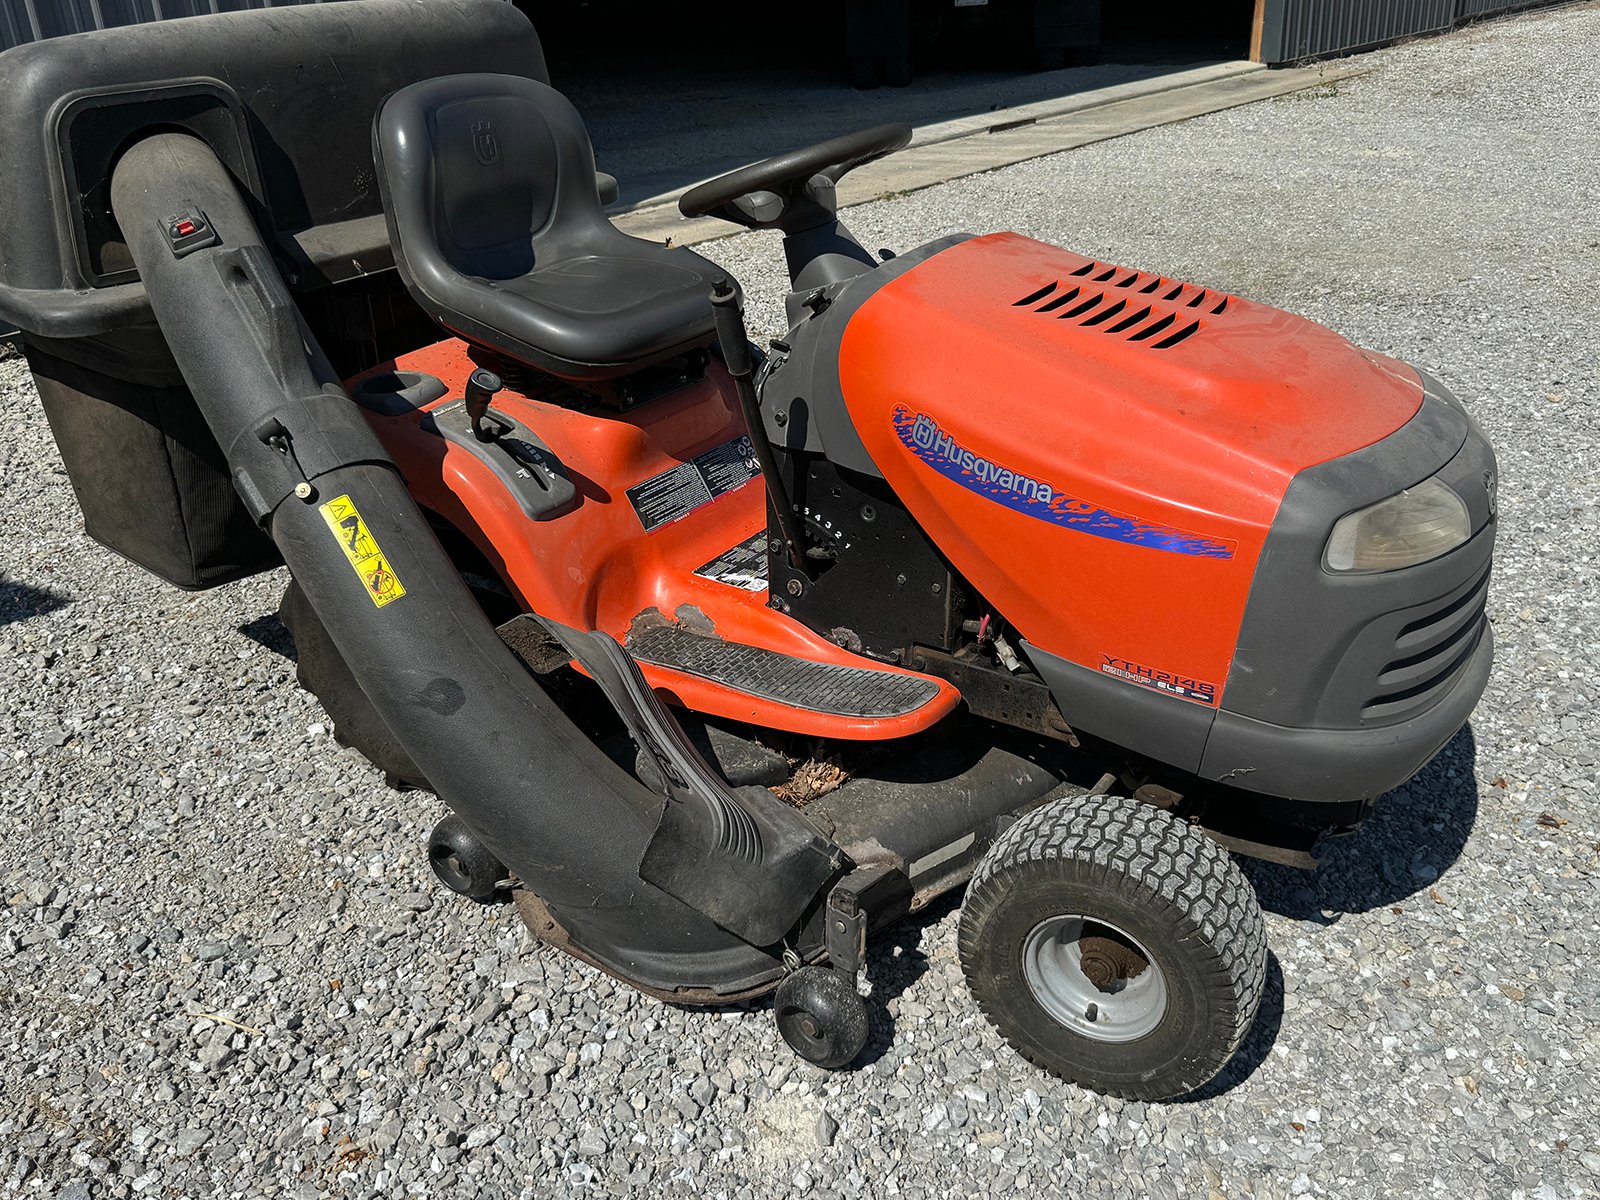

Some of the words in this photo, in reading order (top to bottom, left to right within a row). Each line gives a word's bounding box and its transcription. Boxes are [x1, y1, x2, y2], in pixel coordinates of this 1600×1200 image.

[933, 430, 1053, 504] Husqvarna
[792, 503, 799, 512] 6
[803, 506, 810, 515] 5
[814, 514, 821, 522] 4
[824, 521, 832, 529] 3
[834, 530, 842, 539] 2
